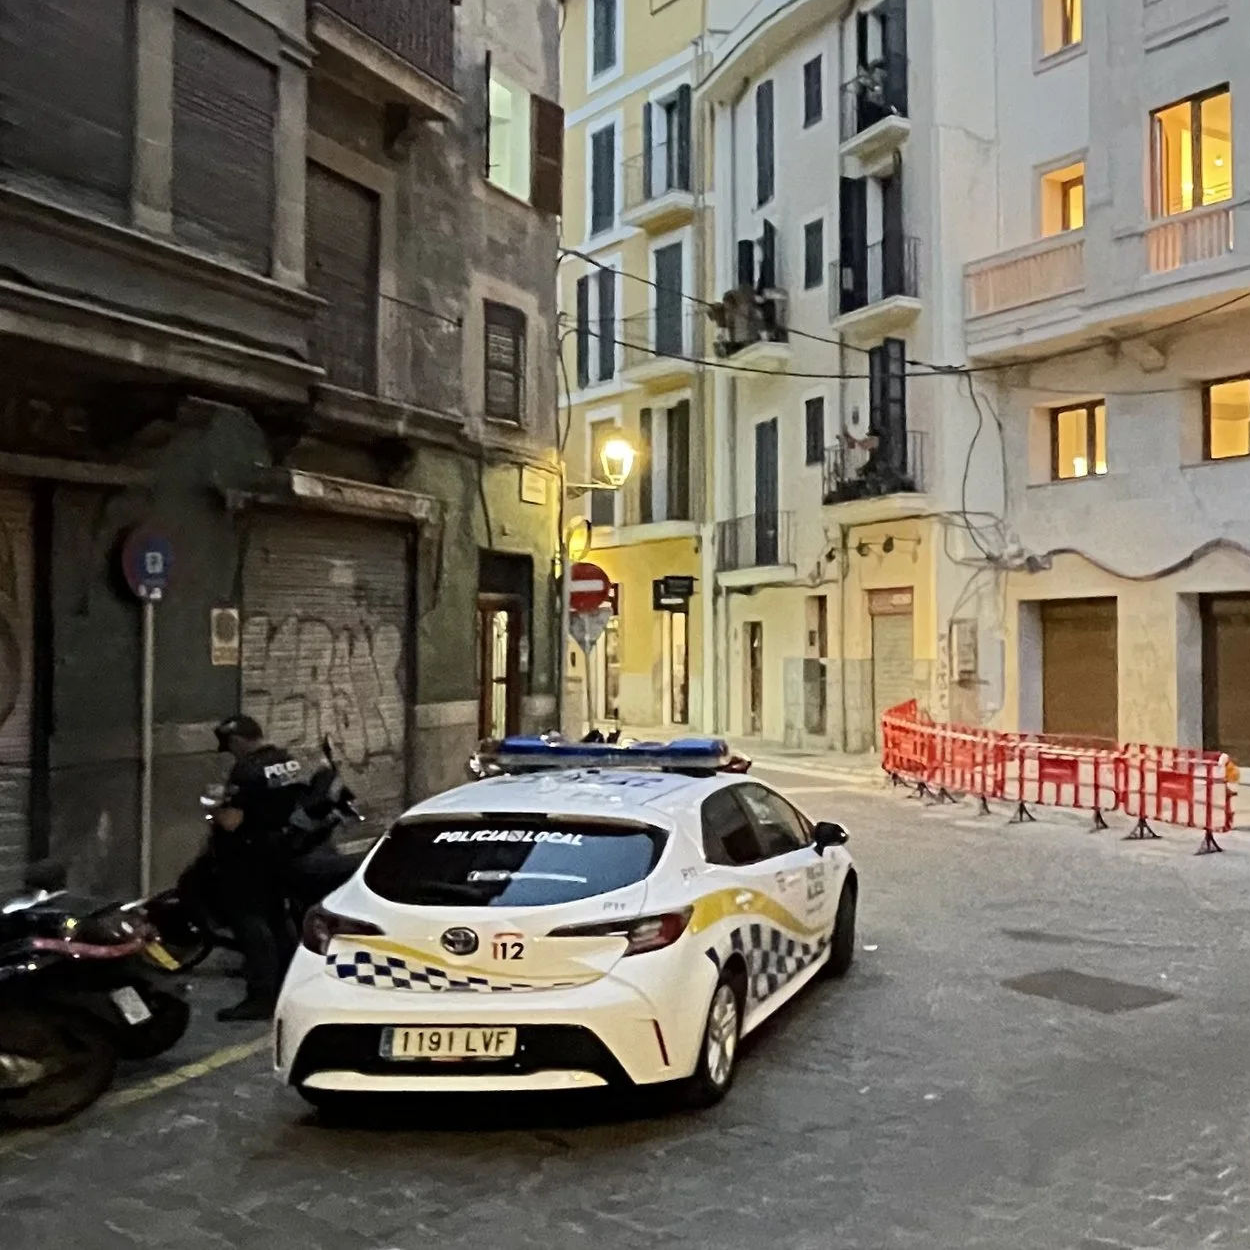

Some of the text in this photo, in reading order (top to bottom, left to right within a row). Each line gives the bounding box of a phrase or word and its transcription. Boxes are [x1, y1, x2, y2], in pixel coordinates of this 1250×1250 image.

[433, 829, 583, 846] POLICIA LOCAL
[492, 941, 525, 960] 112
[403, 1031, 509, 1052] 1191 LVF
